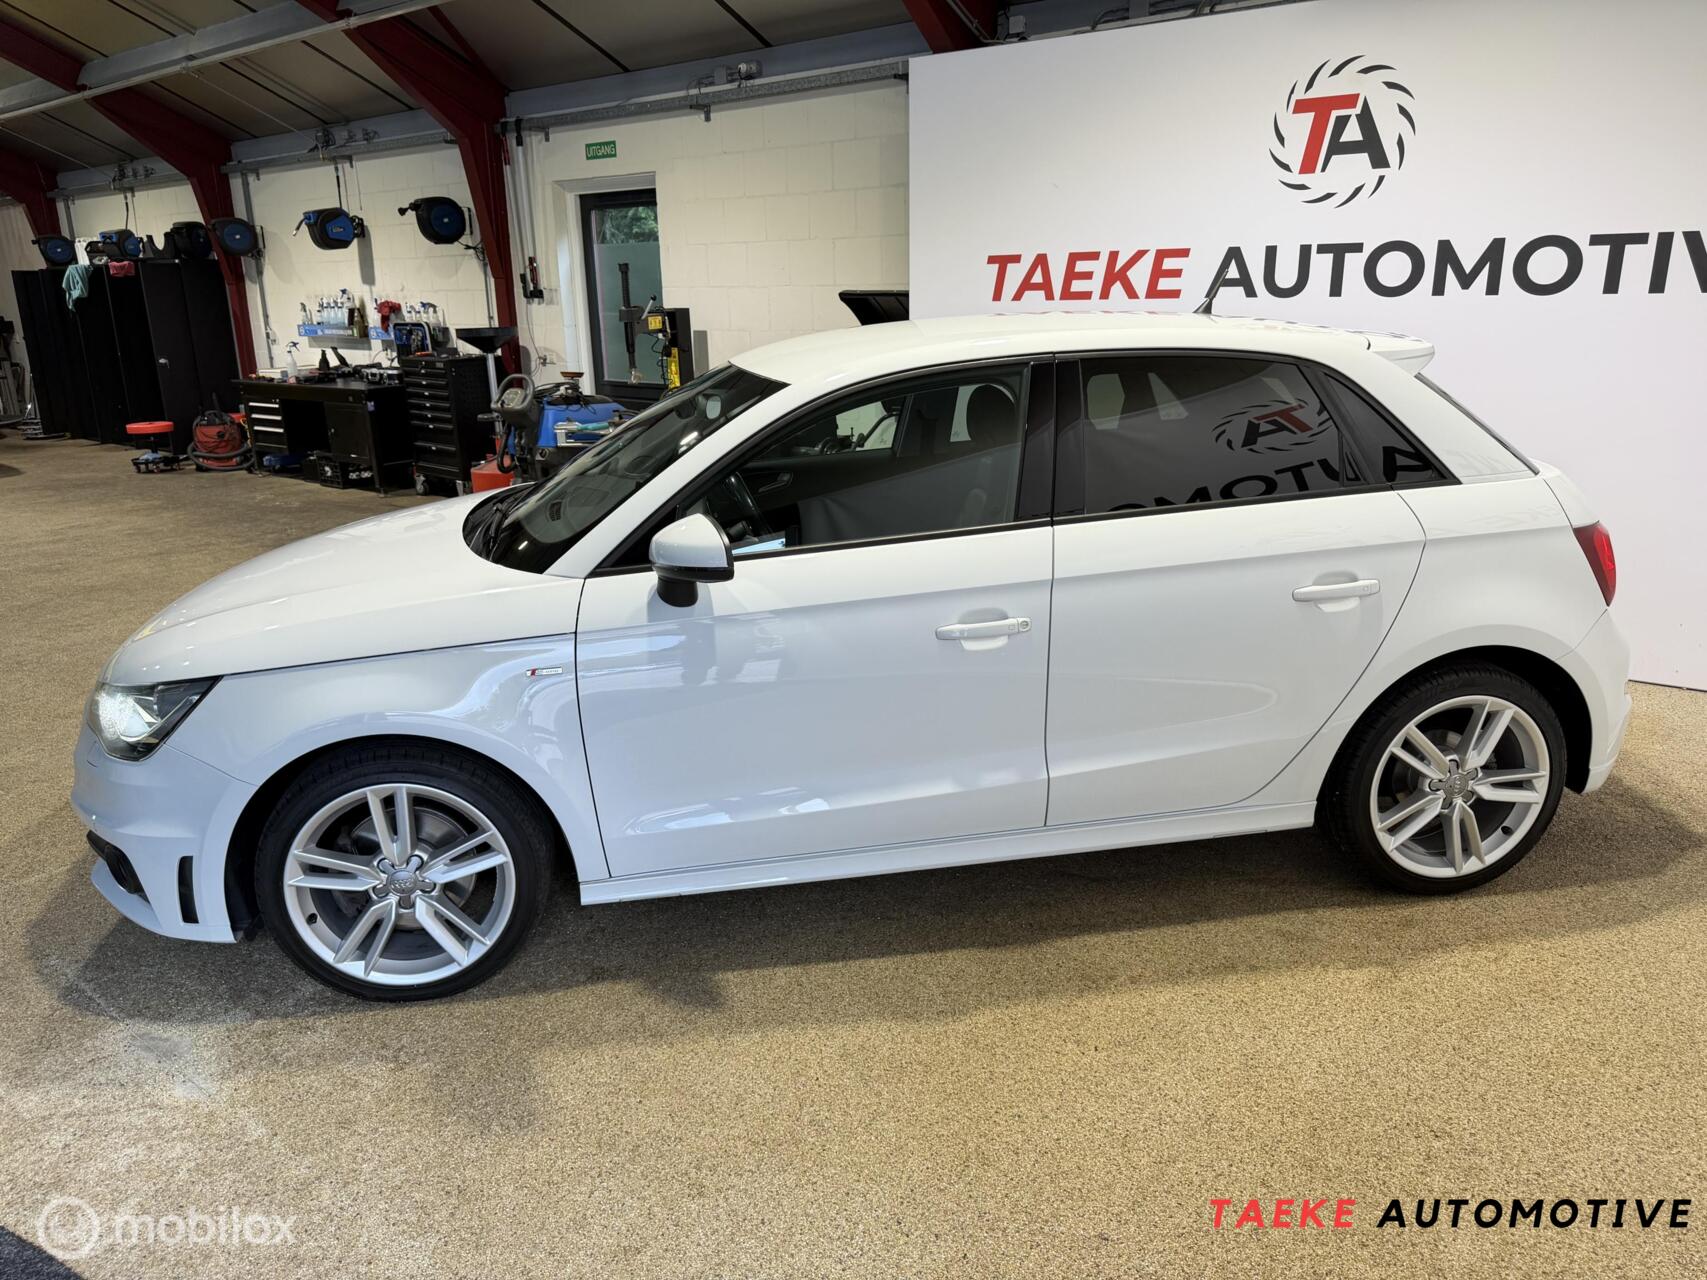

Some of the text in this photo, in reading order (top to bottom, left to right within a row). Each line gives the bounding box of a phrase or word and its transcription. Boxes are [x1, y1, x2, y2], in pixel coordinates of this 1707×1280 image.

[586, 143, 615, 158] UITGANG
[1292, 93, 1391, 175] TA
[987, 248, 1191, 301] TAEKE
